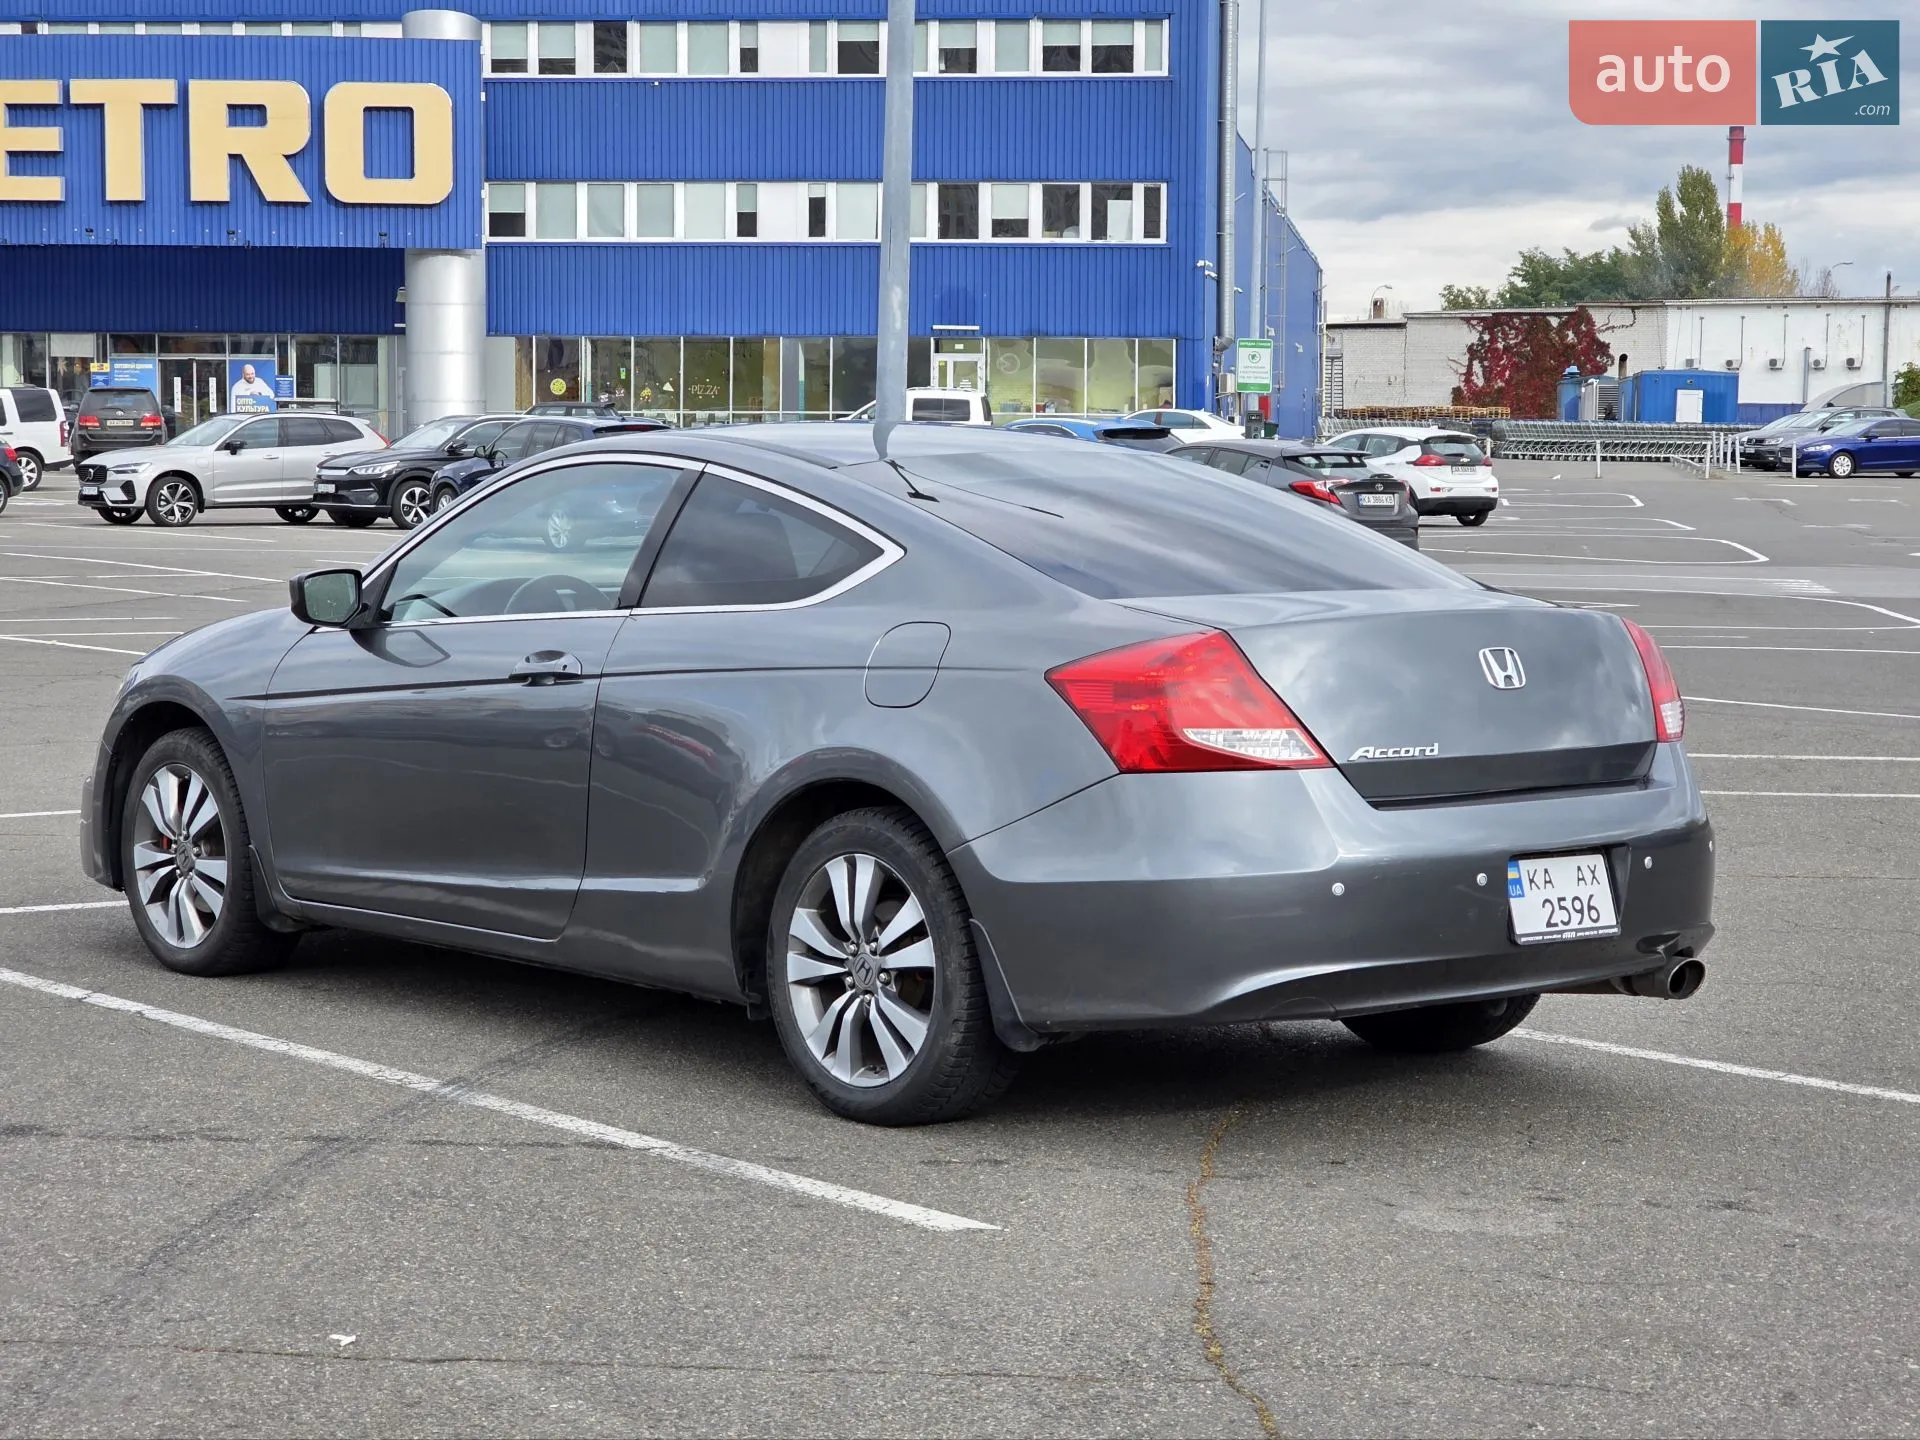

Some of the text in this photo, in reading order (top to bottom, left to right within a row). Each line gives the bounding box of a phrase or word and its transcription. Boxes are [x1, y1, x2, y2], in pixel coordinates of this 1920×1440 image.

[691, 384, 718, 395] PIZZA
[236, 405, 269, 413] КУЛЬТУРА
[1348, 742, 1439, 762] Accord
[1527, 864, 1601, 891] KA AX
[1509, 884, 1523, 897] UA
[1541, 894, 1601, 929] 2596
